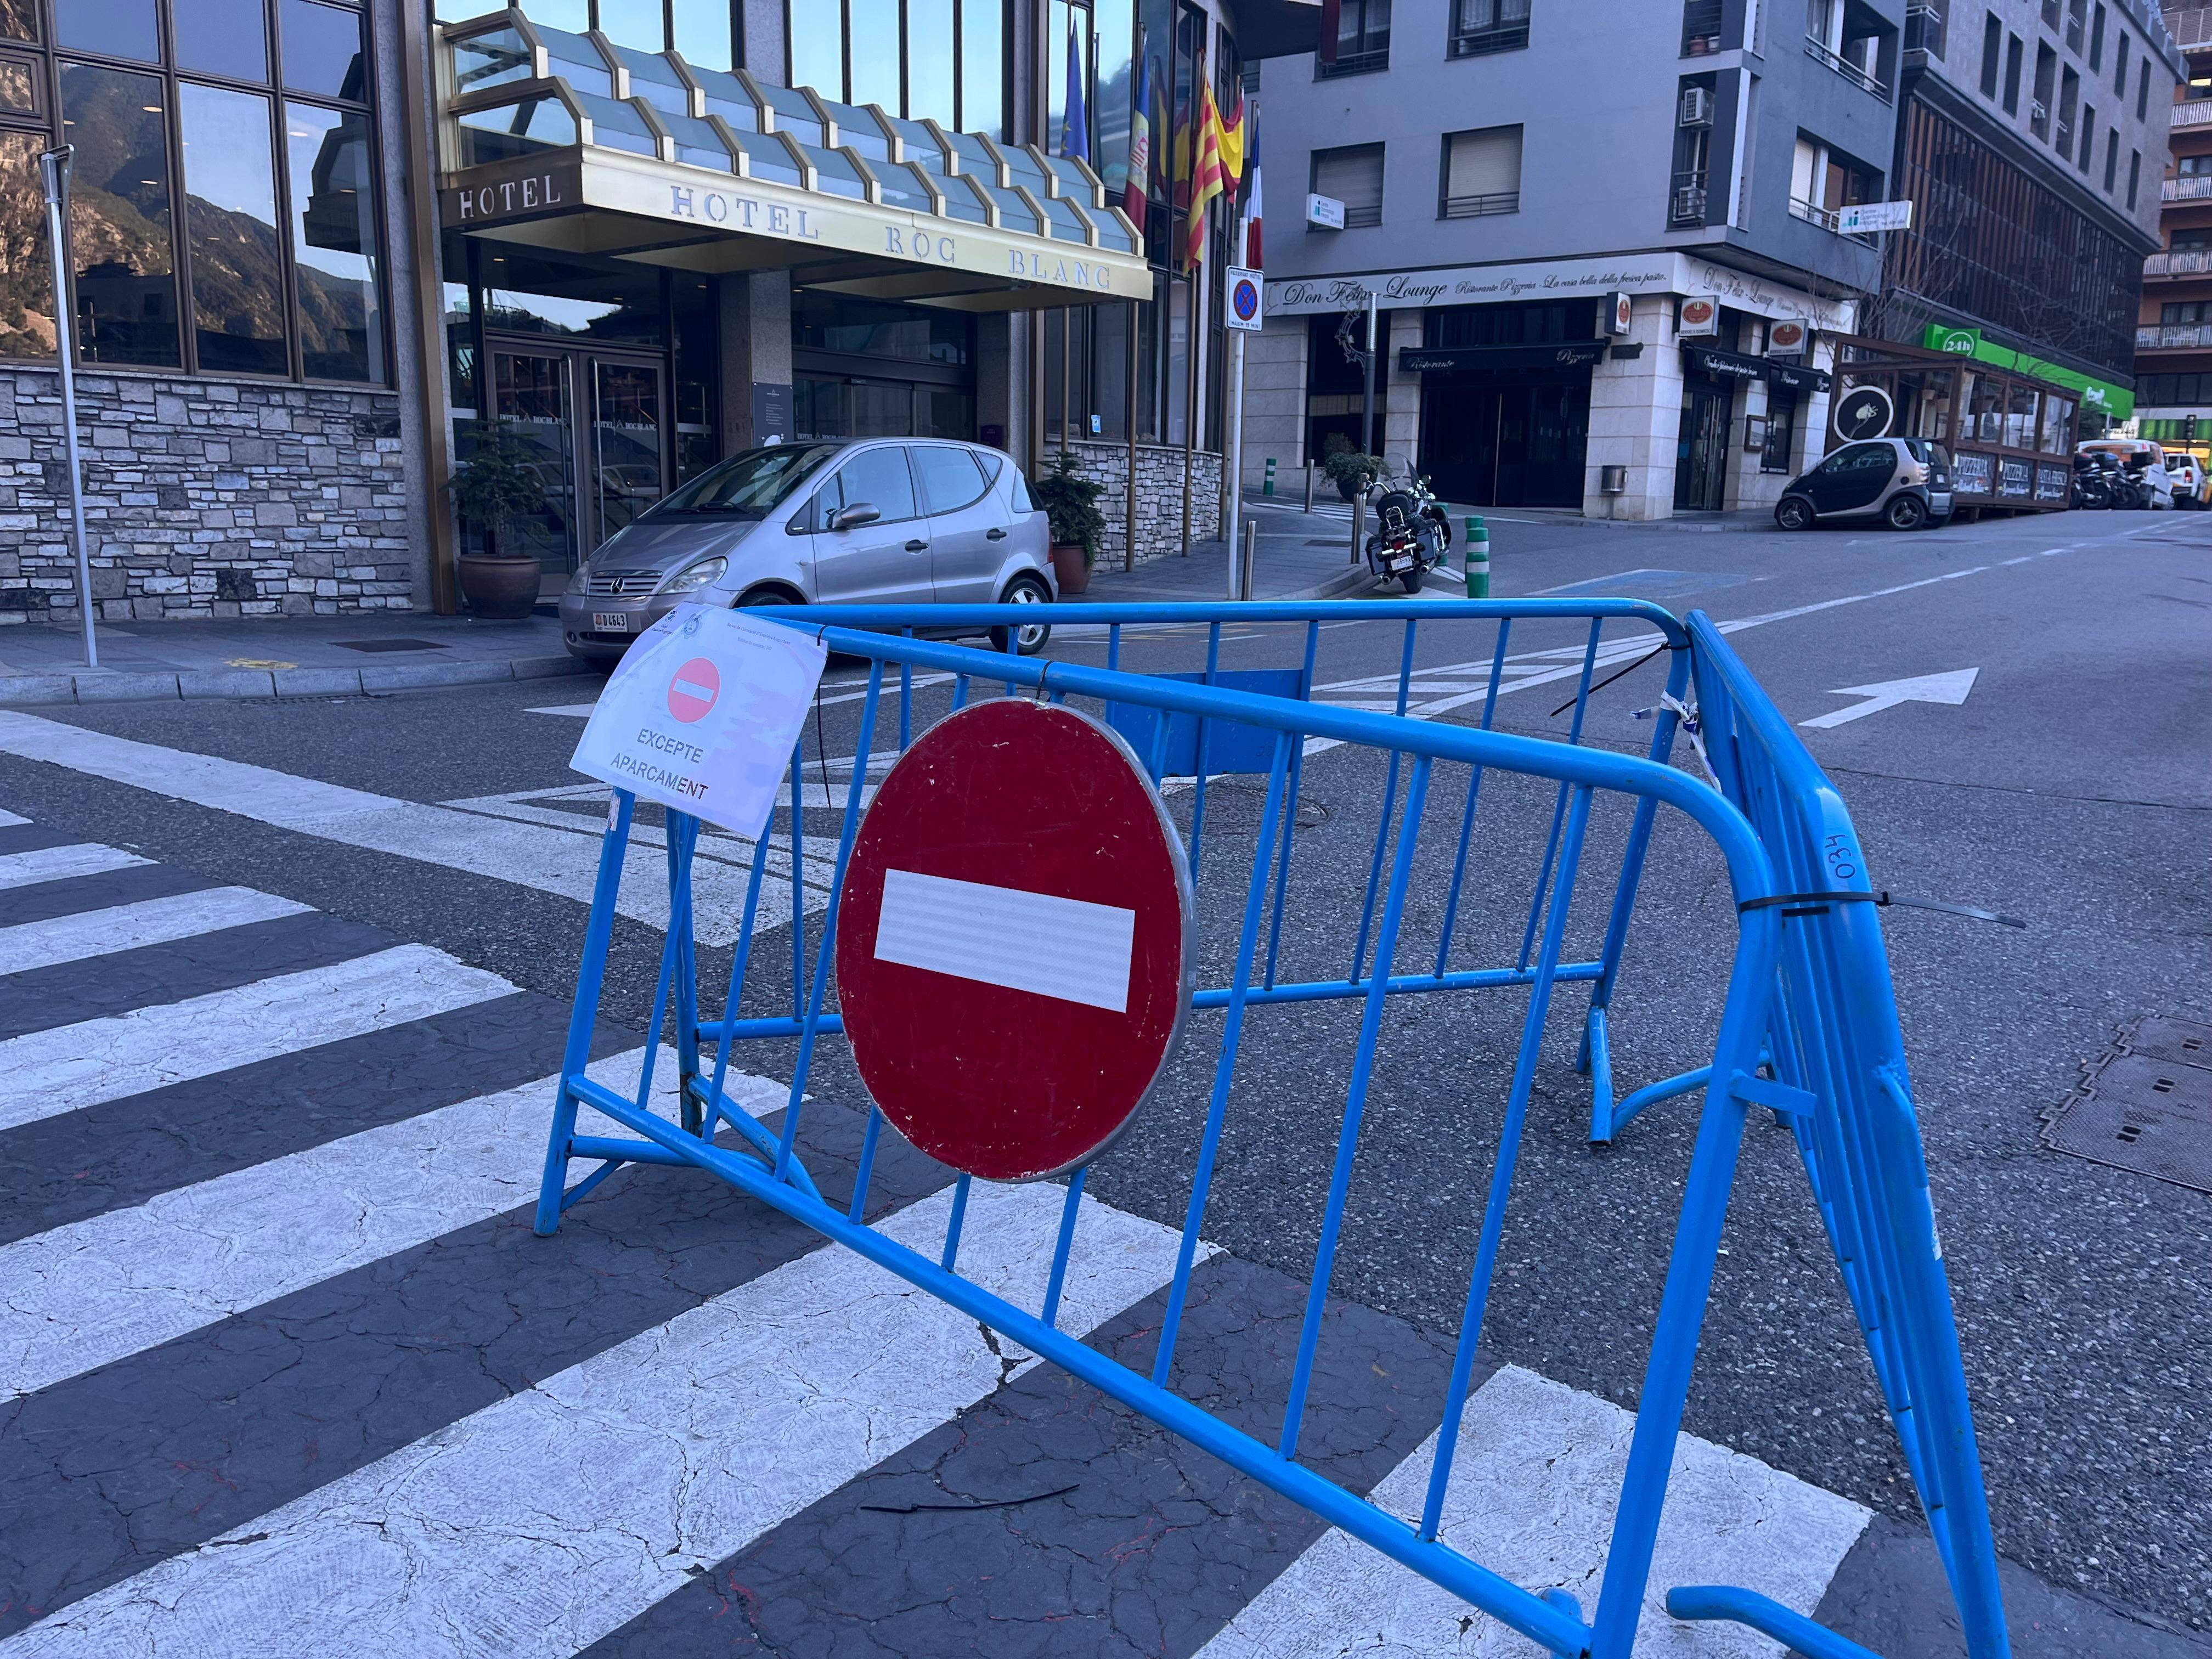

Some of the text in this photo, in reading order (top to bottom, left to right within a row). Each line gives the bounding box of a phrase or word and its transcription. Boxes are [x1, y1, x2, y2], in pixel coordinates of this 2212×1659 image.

[460, 176, 561, 219] HOTEL
[670, 185, 1110, 289] HOTEL ROC BLANC
[1283, 283, 1321, 306] Don
[1383, 275, 1447, 306] Lounge
[1946, 341, 1971, 351] 24h
[636, 727, 703, 764] EXCEPTE
[610, 753, 709, 799] APARCAMENT
[1825, 834, 1856, 879] 034
